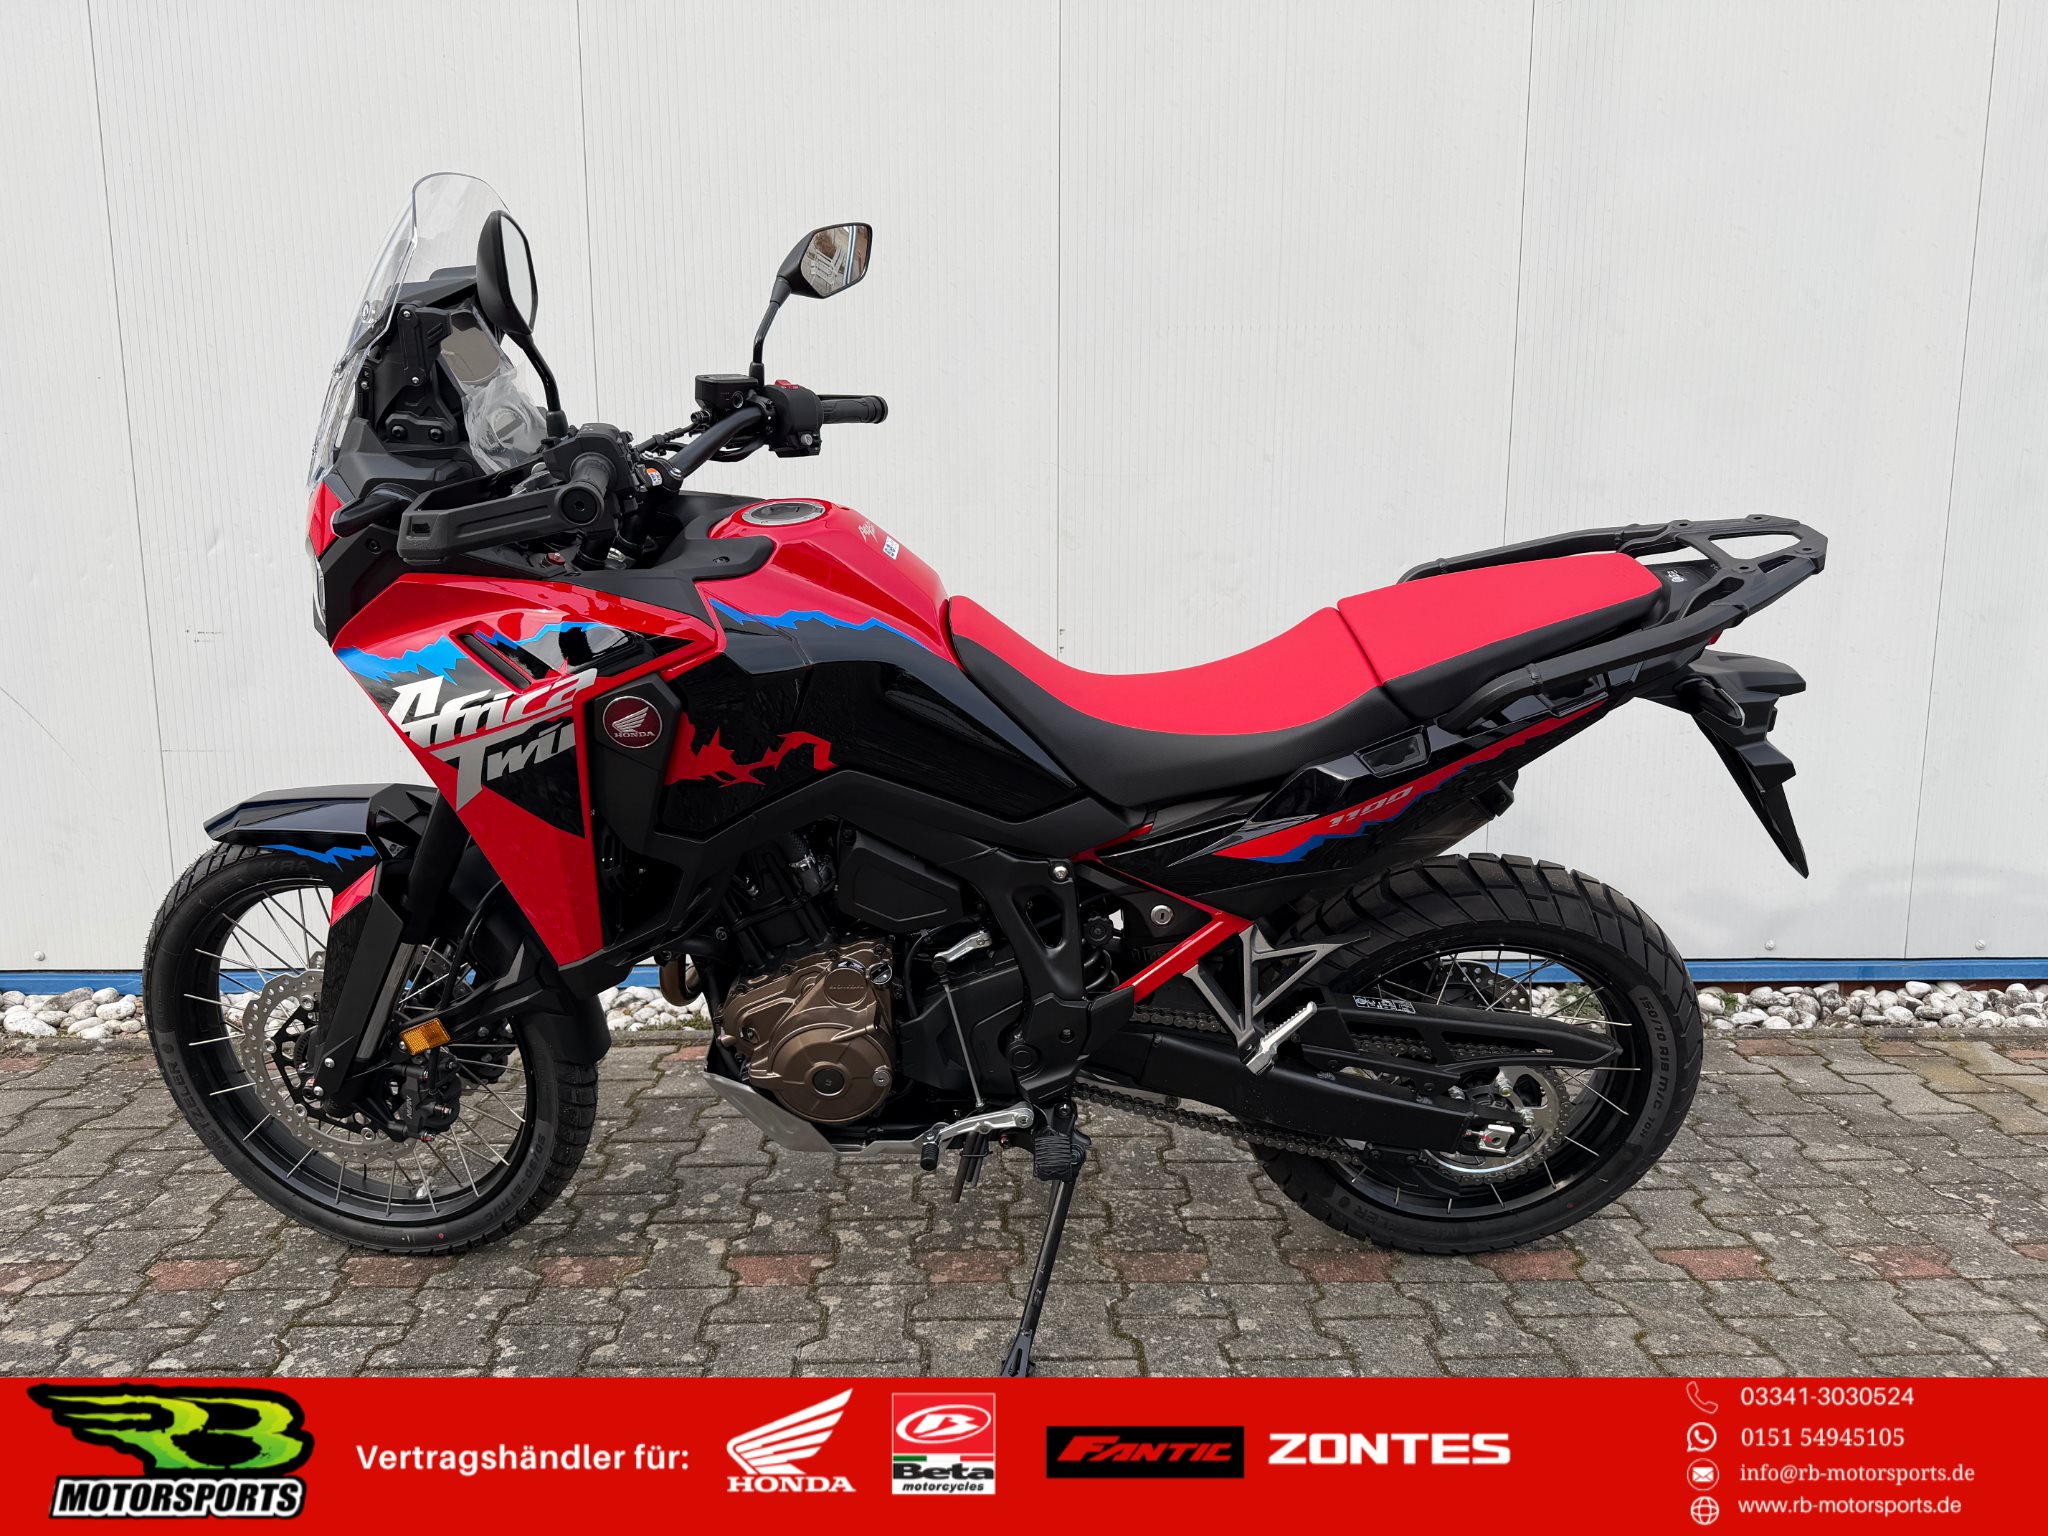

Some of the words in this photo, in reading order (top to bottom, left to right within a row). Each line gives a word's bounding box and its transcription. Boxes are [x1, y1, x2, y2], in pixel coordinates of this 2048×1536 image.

[388, 668, 597, 748] Africa
[1329, 786, 1414, 828] 1100
[167, 1061, 233, 1157] METZELER
